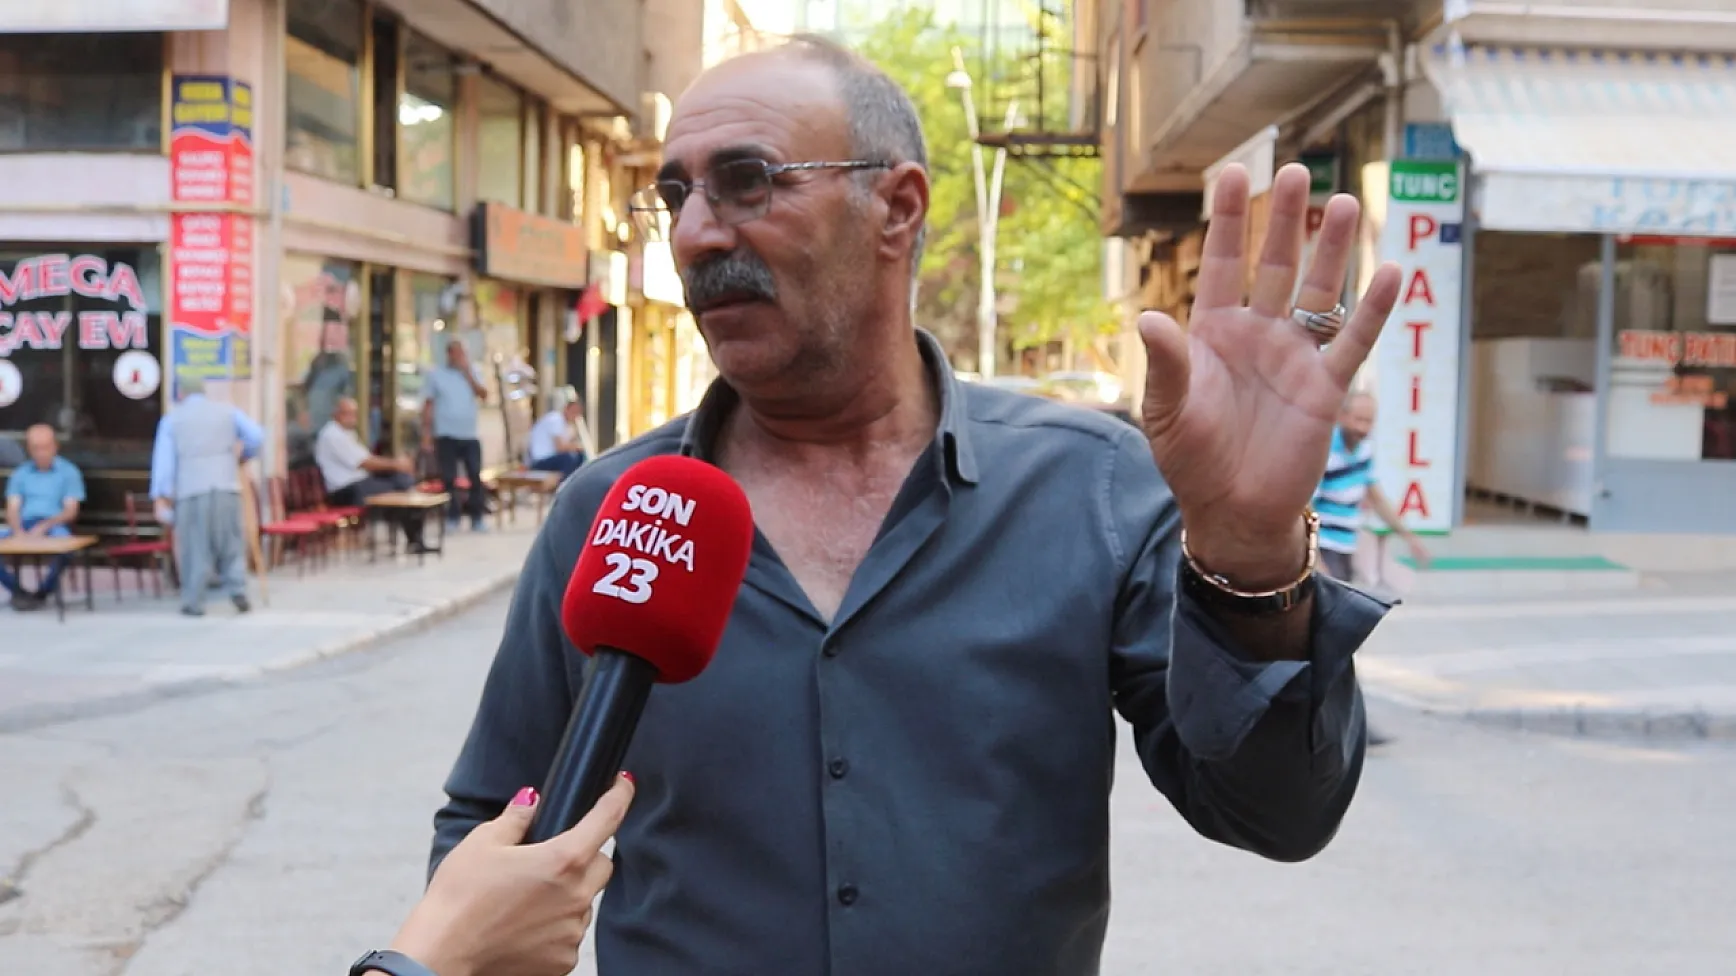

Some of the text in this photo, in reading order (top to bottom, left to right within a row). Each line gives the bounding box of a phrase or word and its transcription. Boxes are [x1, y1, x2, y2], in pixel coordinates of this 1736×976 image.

[1392, 172, 1456, 199] TUNÇ
[621, 484, 697, 527] SON
[592, 519, 694, 573] DAKİKA
[592, 552, 659, 604] 23
